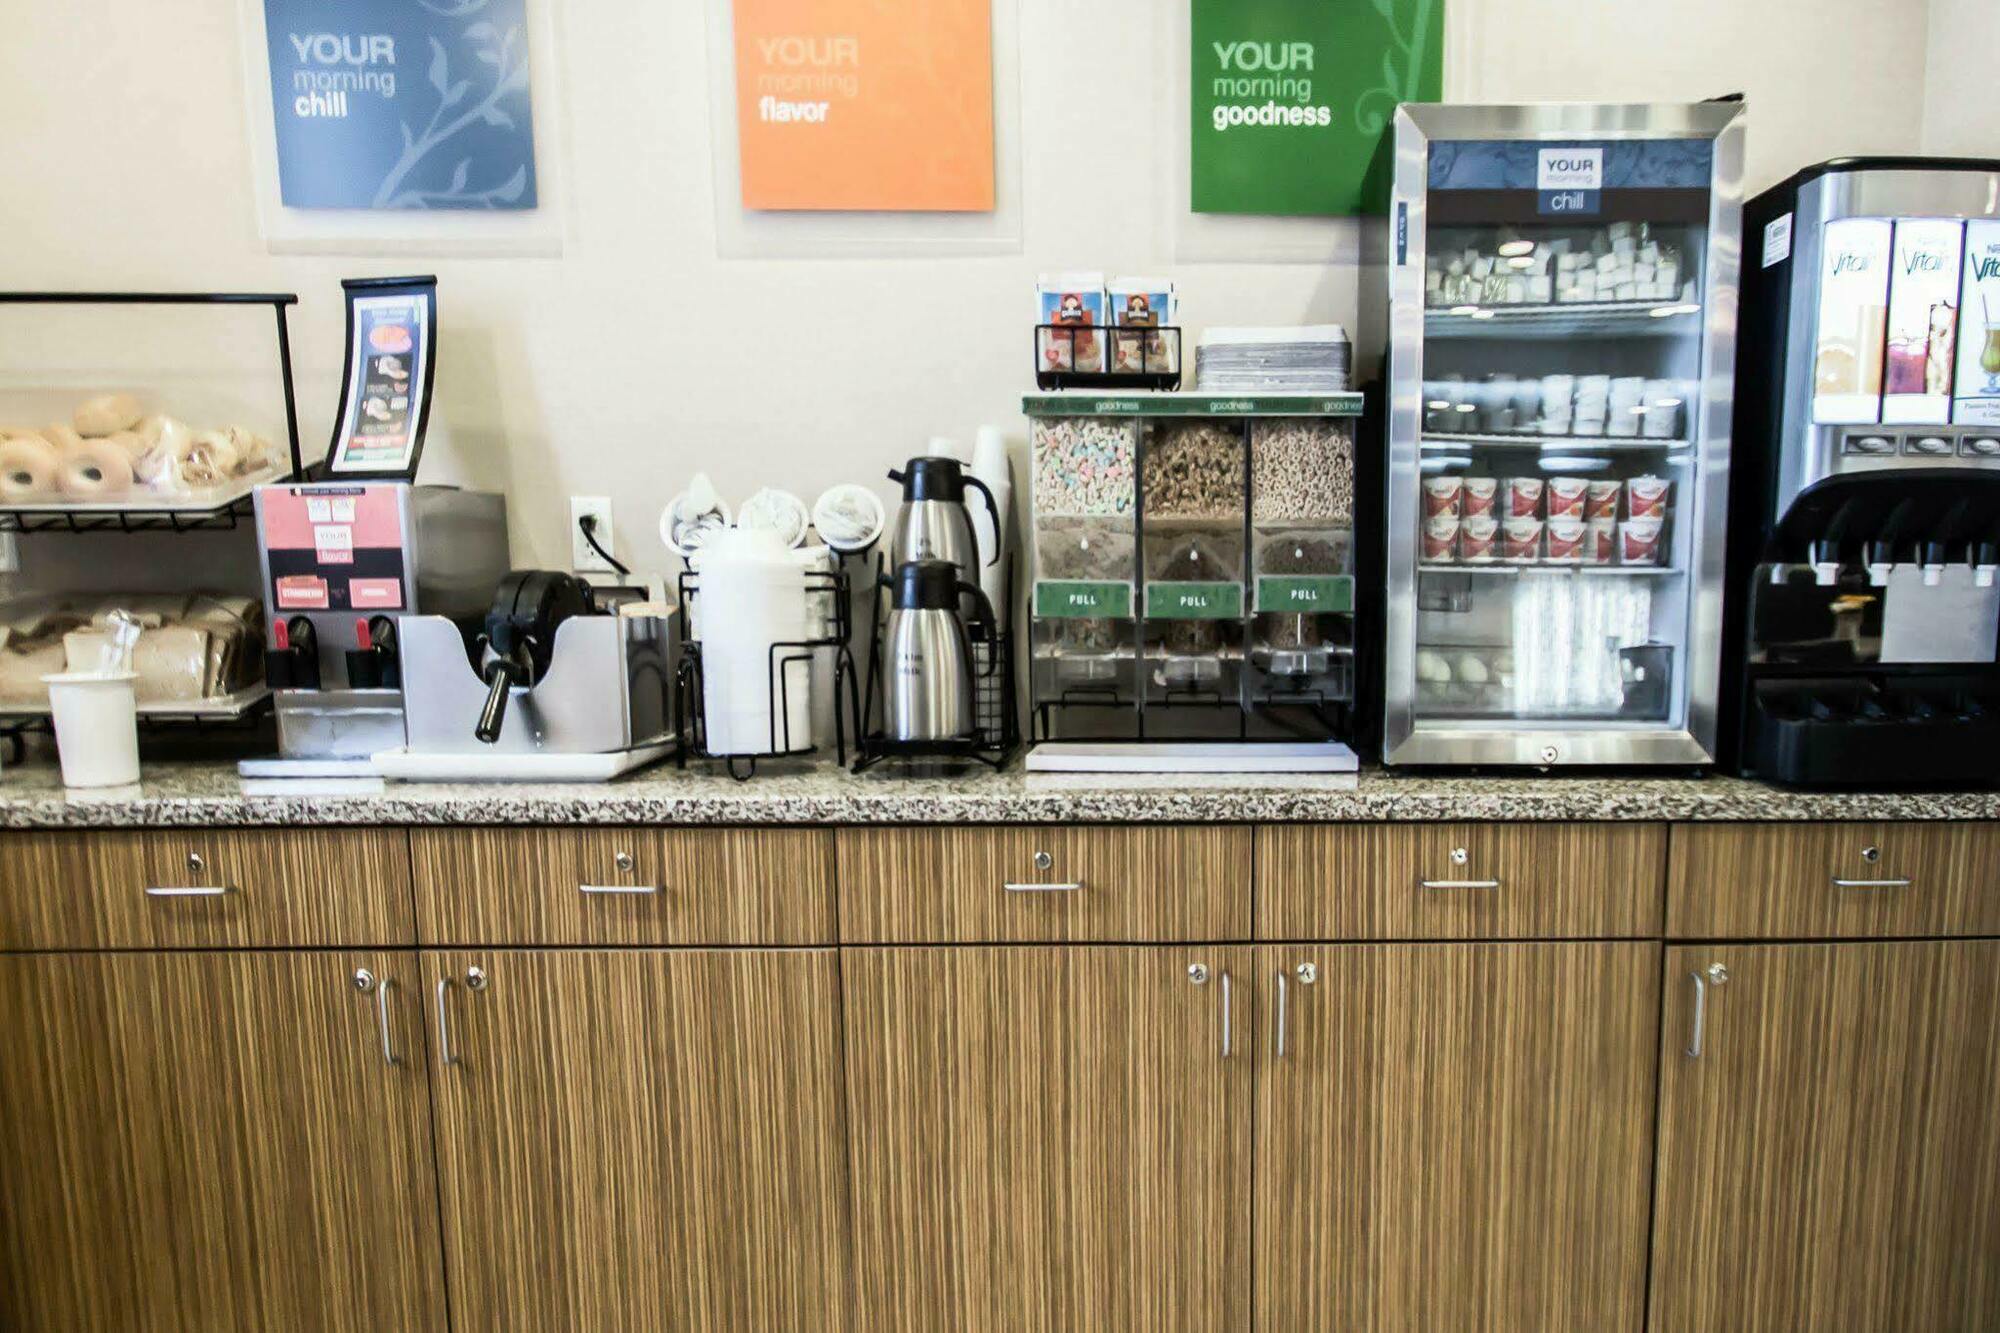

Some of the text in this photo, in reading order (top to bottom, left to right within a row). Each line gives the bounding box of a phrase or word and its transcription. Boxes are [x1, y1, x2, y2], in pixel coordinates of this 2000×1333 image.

[290, 34, 396, 64] YOUR
[758, 37, 859, 65] YOUR
[1213, 42, 1314, 71] YOUR
[293, 66, 396, 97] morning
[759, 68, 859, 98] morning
[1213, 72, 1312, 103] morning
[295, 90, 348, 118] chill
[759, 96, 829, 123] flavor
[1213, 101, 1331, 130] goodness
[1546, 159, 1594, 172] YOUR
[1552, 191, 1584, 211] chill
[1095, 401, 1139, 412] goodness
[1210, 401, 1253, 412] goodness
[1070, 594, 1096, 605] PULL
[1180, 596, 1207, 607] PULL
[1291, 589, 1317, 600] PULL
